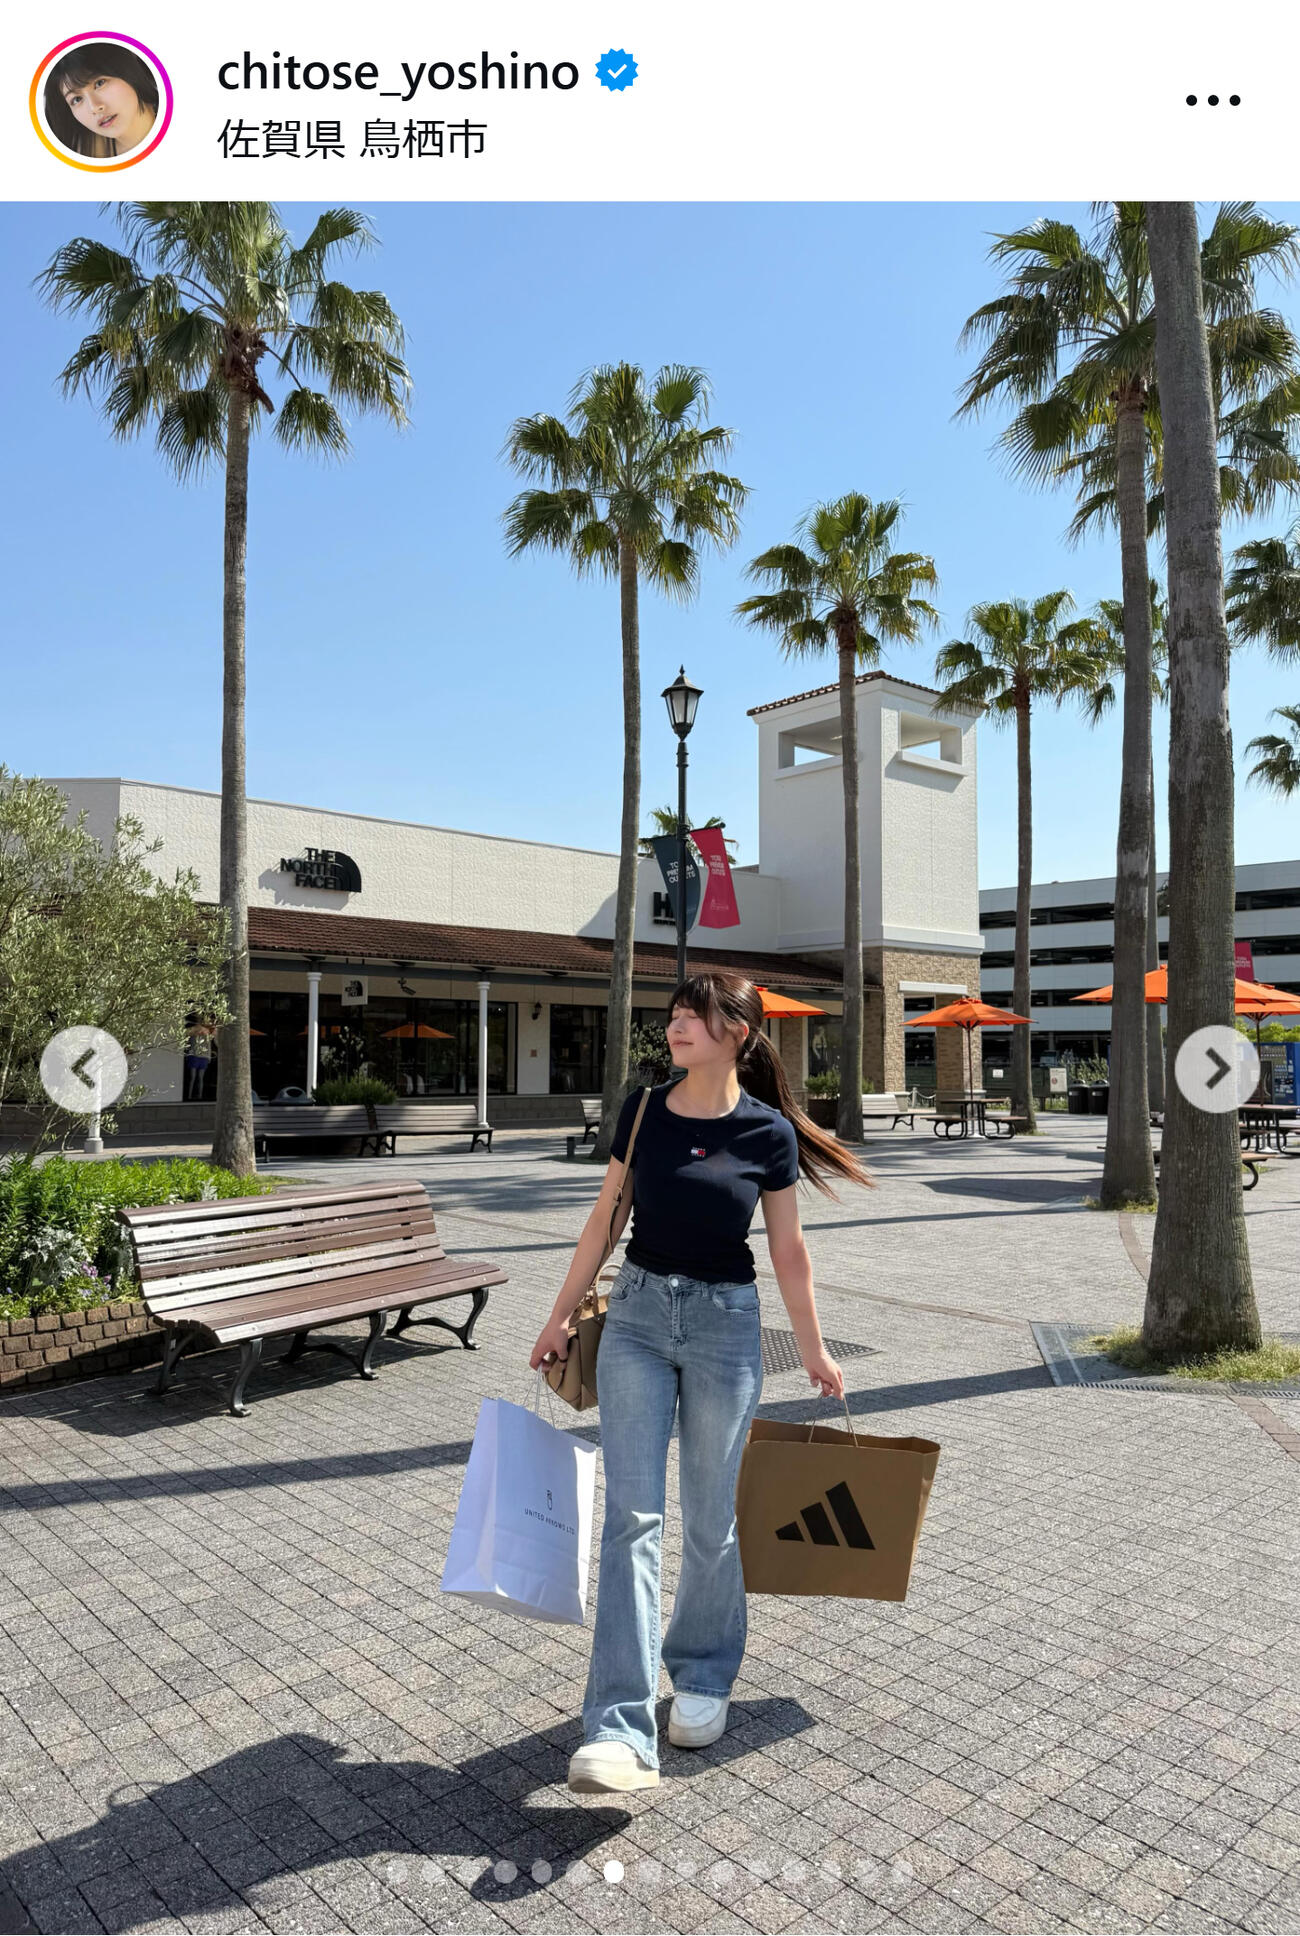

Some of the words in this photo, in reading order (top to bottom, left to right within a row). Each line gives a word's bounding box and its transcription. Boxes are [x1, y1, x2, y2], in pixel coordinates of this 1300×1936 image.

[305, 847, 336, 862] THE
[280, 858, 337, 877] NORTH
[295, 874, 336, 890] FACE
[524, 1508, 545, 1521] UNITED
